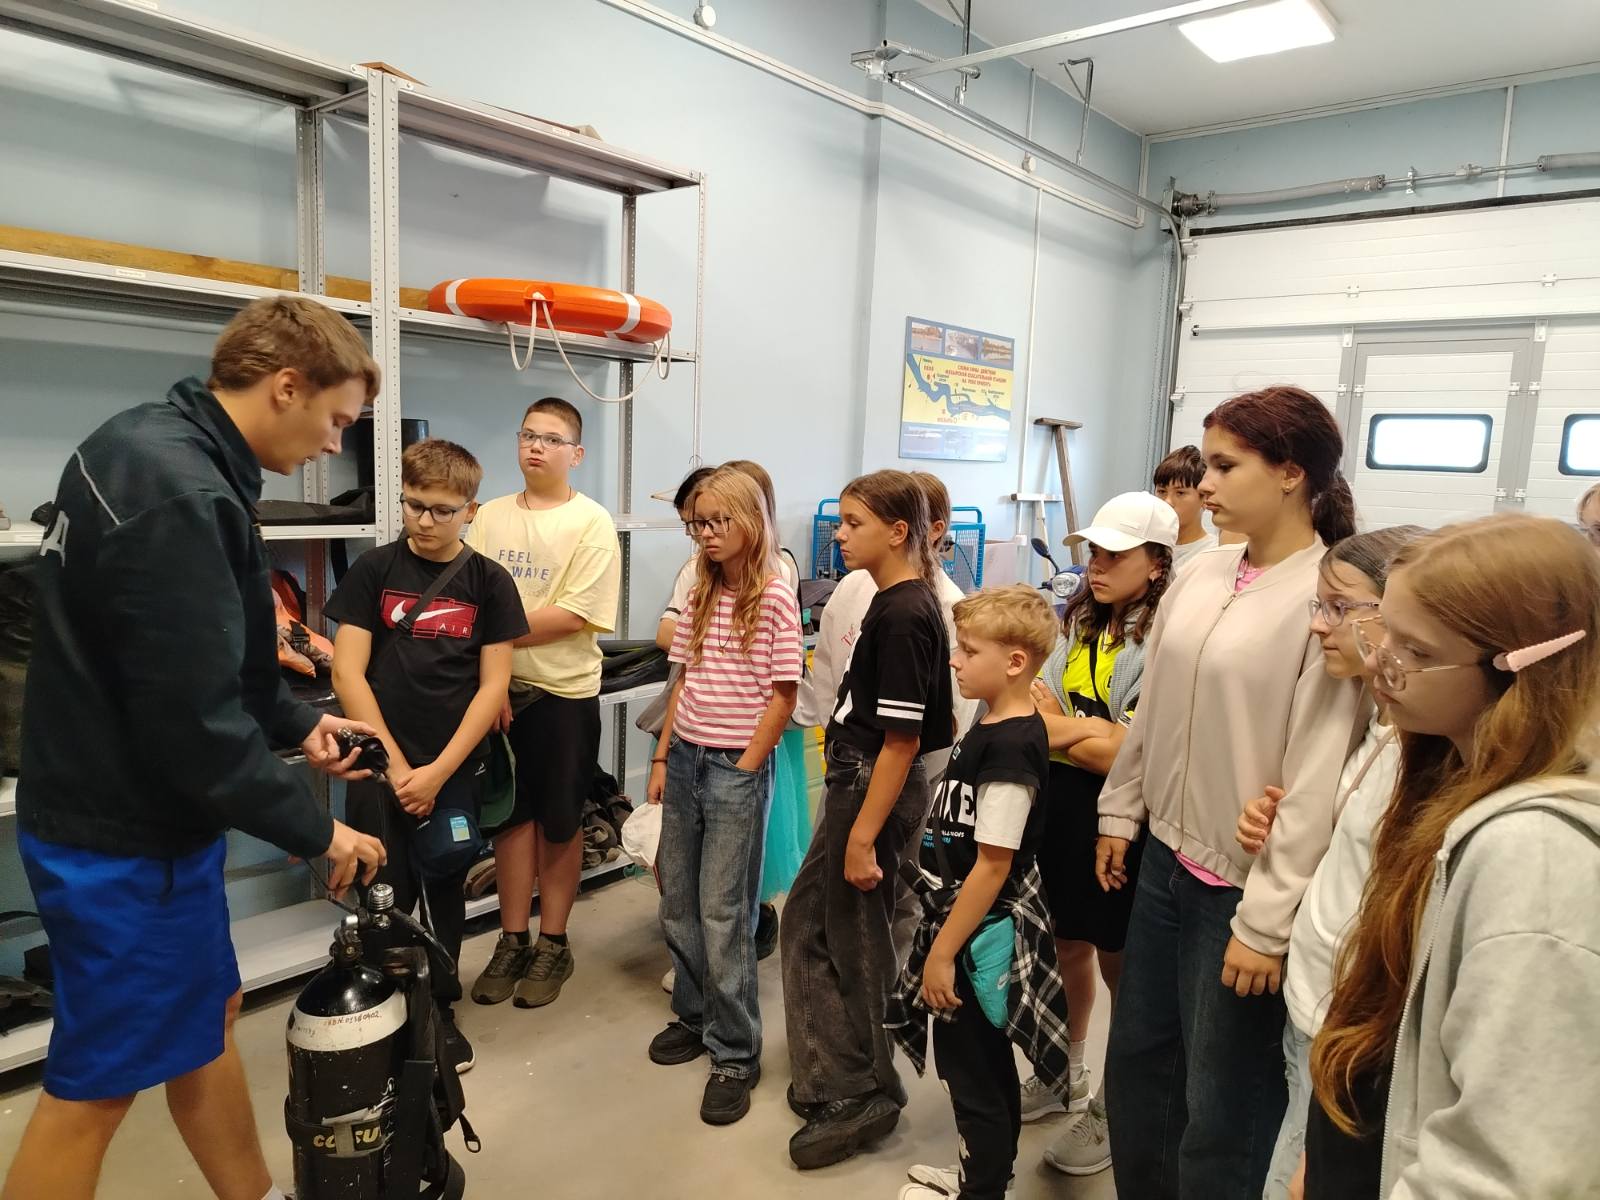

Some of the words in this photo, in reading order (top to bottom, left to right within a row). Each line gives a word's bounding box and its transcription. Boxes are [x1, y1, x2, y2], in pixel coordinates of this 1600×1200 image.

[498, 549, 532, 563] FEEL
[512, 566, 550, 580] WAVE
[439, 622, 468, 634] AIR
